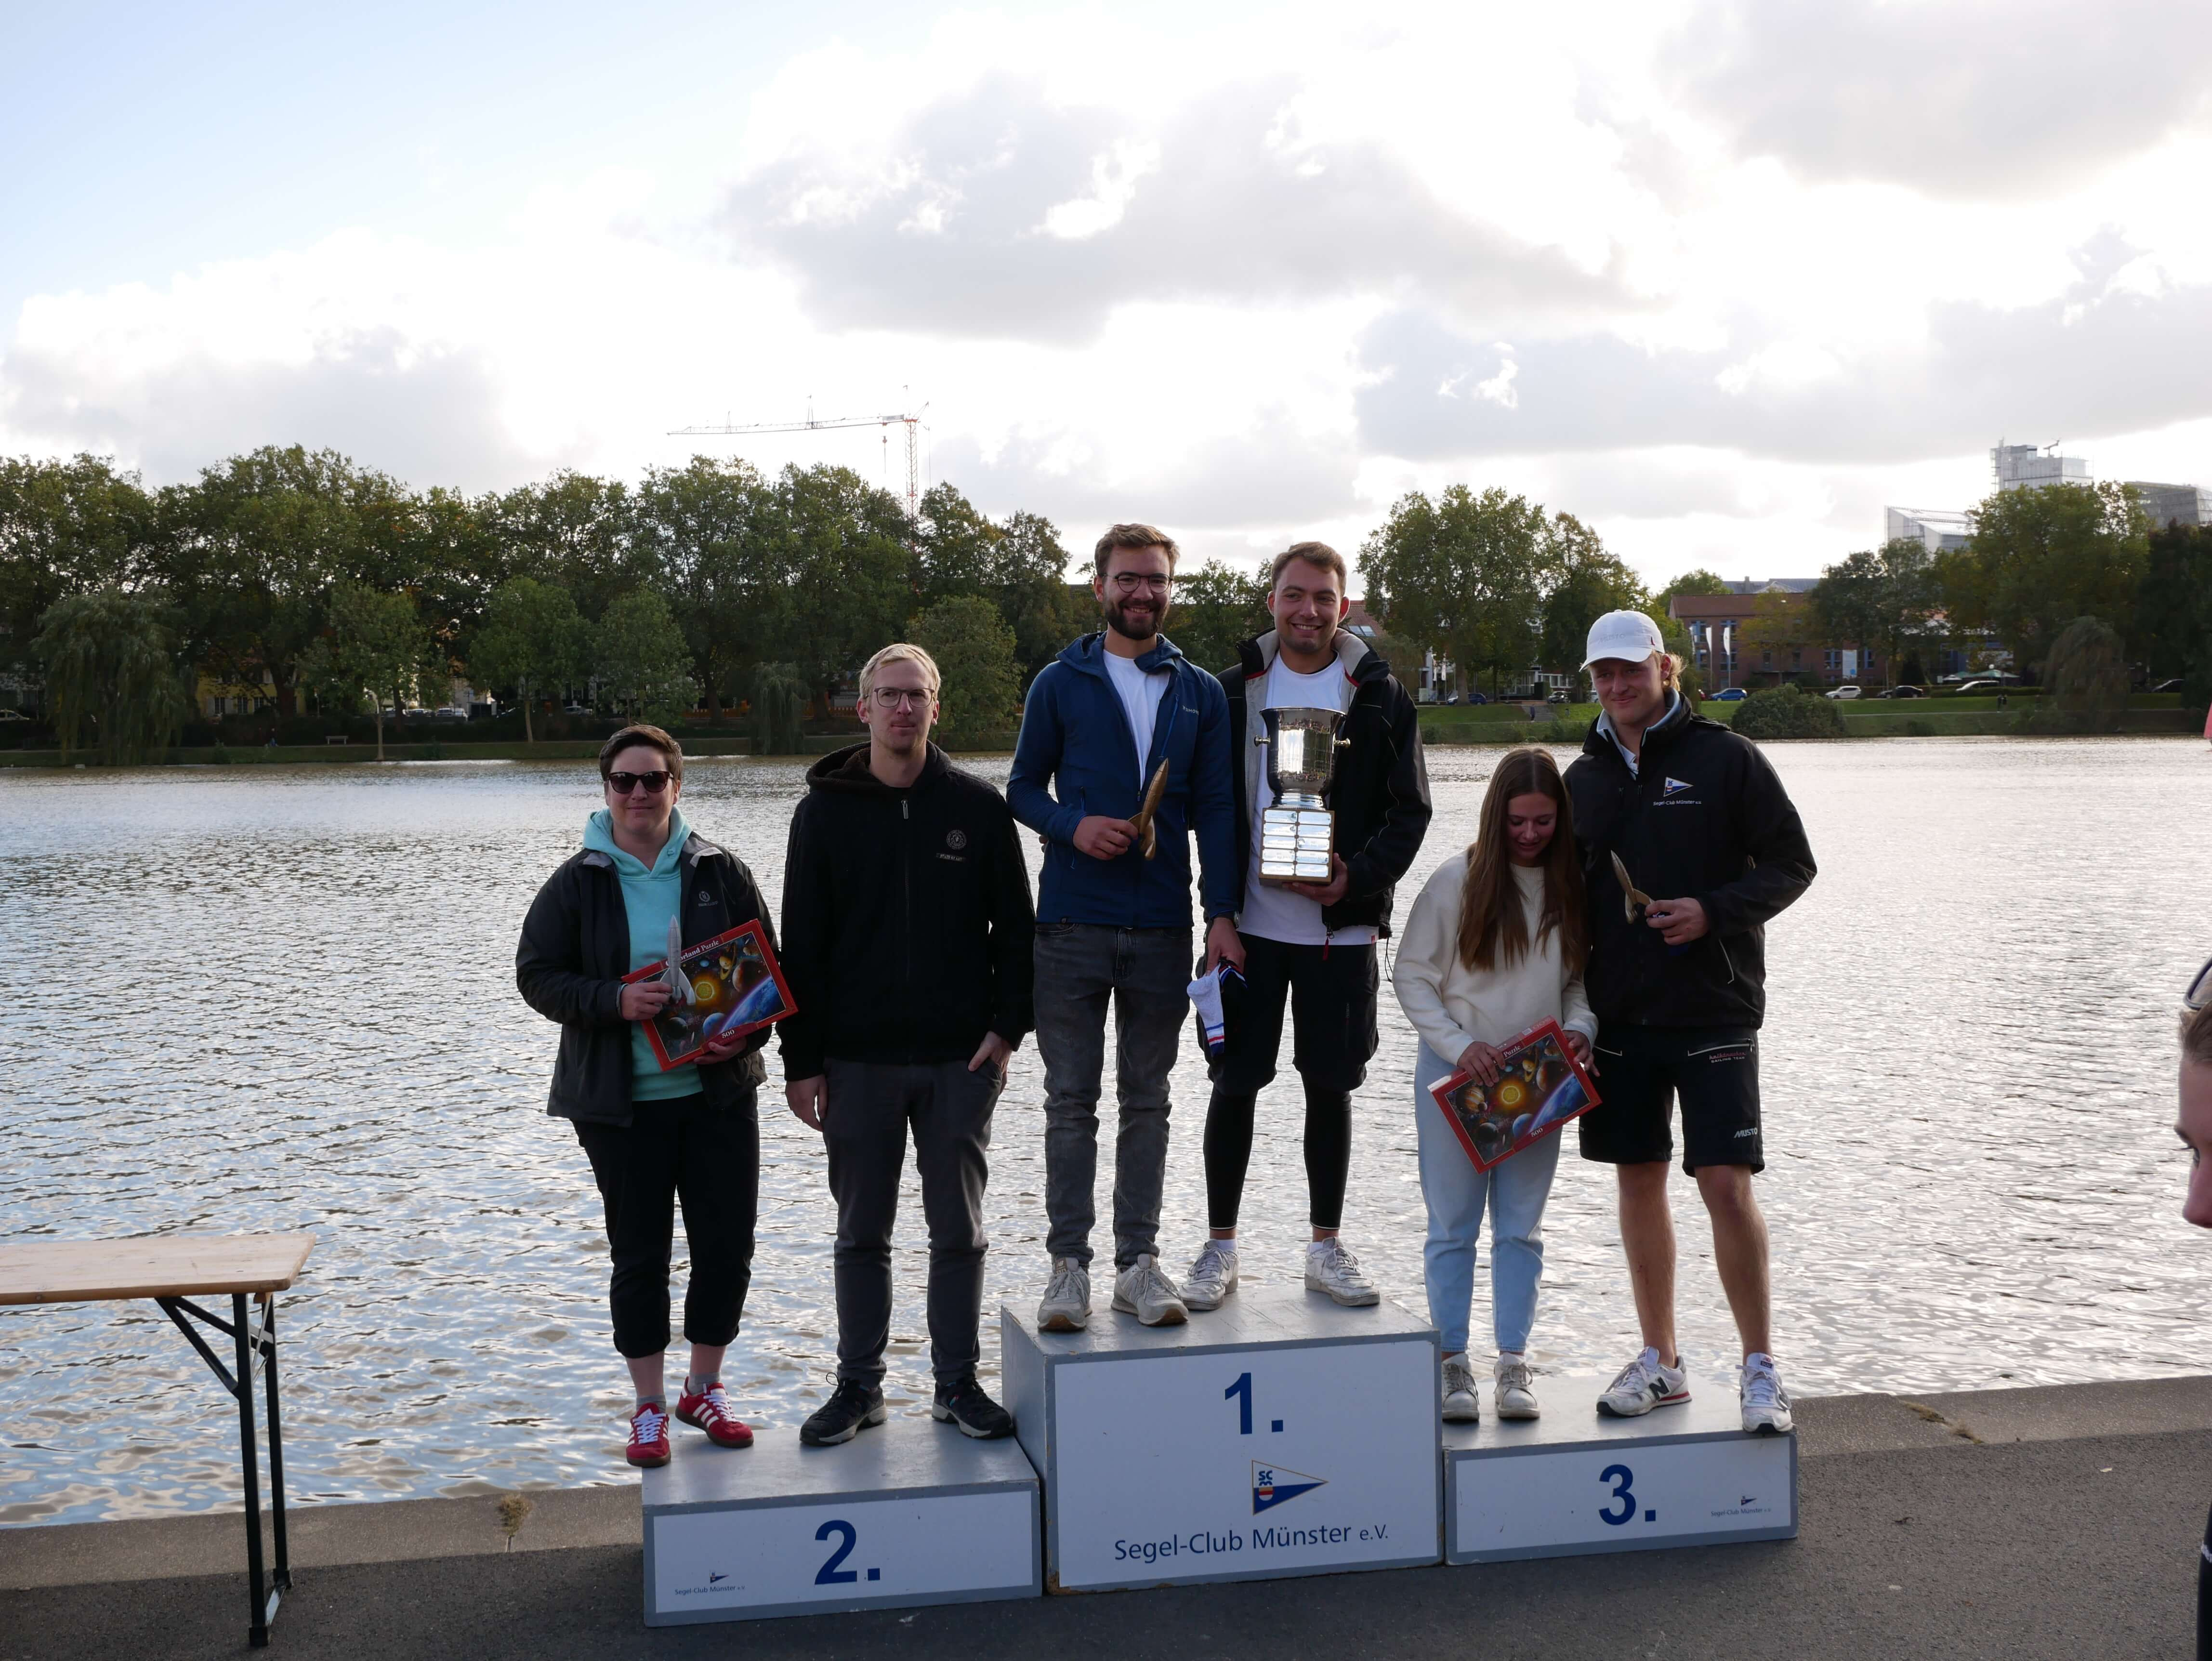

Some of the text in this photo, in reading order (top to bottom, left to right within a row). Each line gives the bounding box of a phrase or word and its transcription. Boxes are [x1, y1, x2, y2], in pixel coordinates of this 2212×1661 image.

[701, 940, 719, 951] Puzzle
[722, 1029, 735, 1038] 500
[1503, 1045, 1521, 1057] Puzzle
[1530, 1127, 1543, 1137] 500
[1734, 1127, 1758, 1138] MUSTO
[1224, 1372, 1284, 1435] 1.
[1598, 1464, 1656, 1526] 3.
[1115, 1524, 1388, 1564] Segel-Club Münster e.V.
[814, 1519, 881, 1585] 2.
[675, 1587, 708, 1596] Segel-Club
